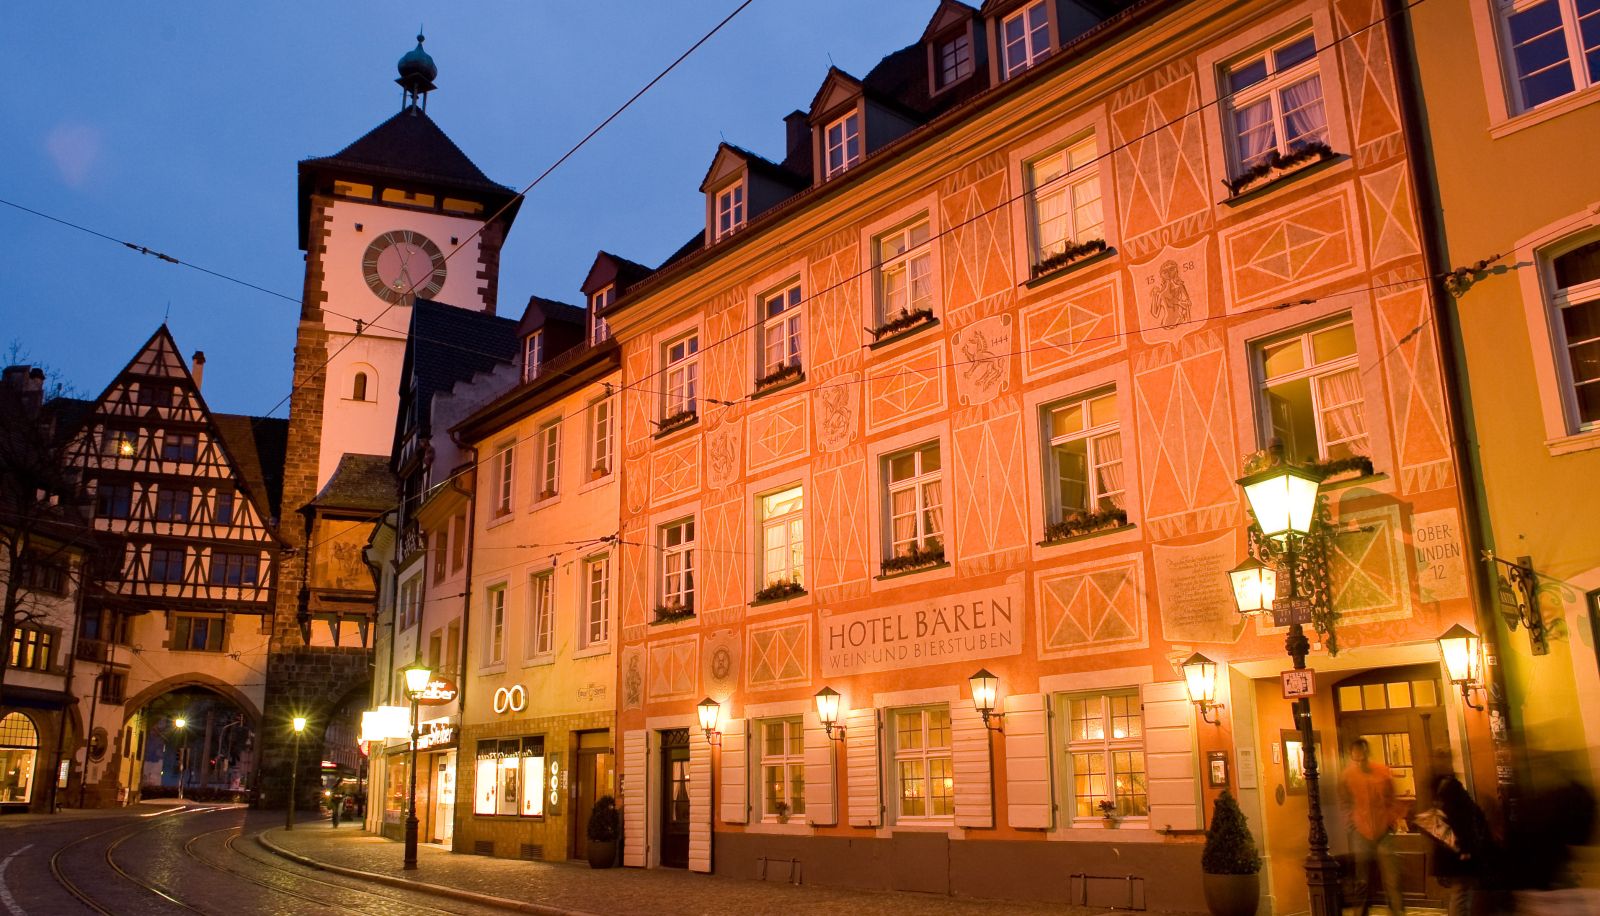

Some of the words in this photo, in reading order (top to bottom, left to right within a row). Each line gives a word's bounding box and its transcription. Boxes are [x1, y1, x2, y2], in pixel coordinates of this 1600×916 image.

[1182, 260, 1195, 273] 58
[991, 333, 1008, 347] 1444
[1416, 524, 1452, 542] OBER-
[1417, 542, 1460, 563] LINDEN
[1429, 564, 1447, 580] 12
[829, 615, 908, 650] HOTEL
[915, 596, 1012, 638] BÄREN
[913, 629, 1012, 658] BIERSTUBEN
